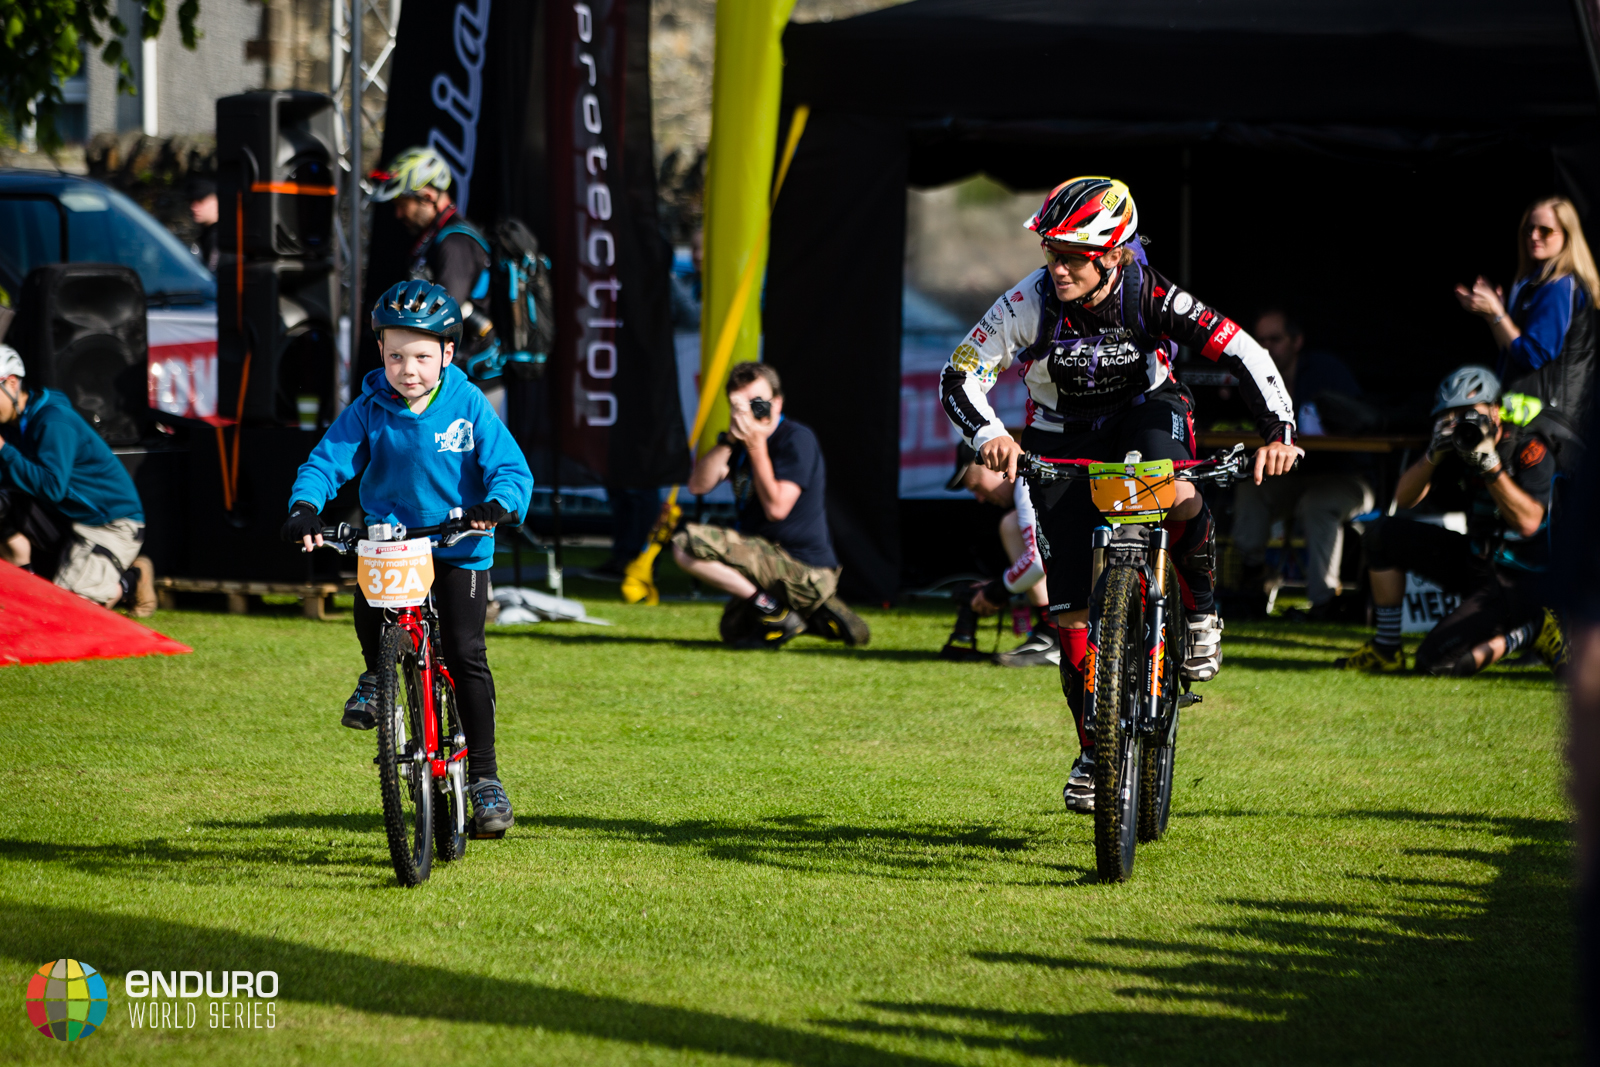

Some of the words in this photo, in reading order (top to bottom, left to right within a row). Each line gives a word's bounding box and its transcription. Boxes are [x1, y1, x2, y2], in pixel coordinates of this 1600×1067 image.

[573, 2, 624, 427] protection
[1053, 354, 1097, 367] FACTOR
[1101, 350, 1140, 368] RACING
[1124, 480, 1138, 505] 1
[363, 559, 385, 568] mighty
[386, 559, 408, 567] mash
[368, 567, 425, 594] 32A
